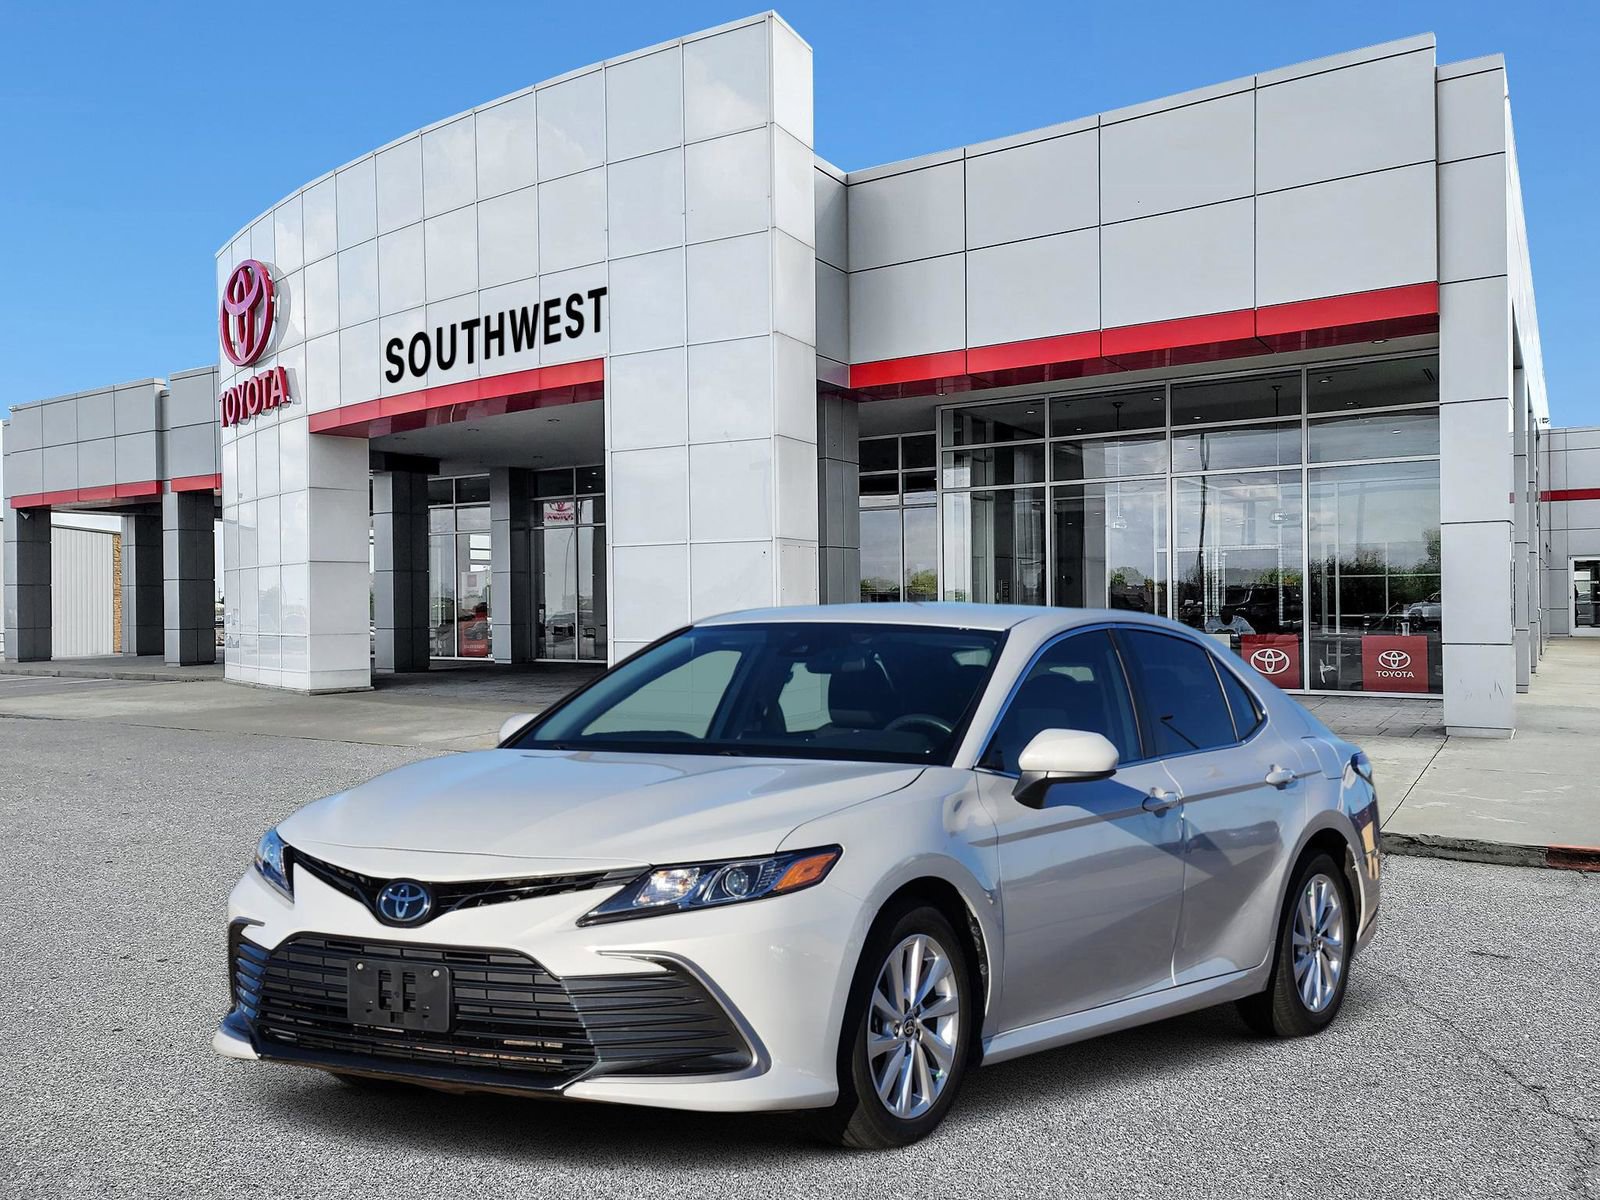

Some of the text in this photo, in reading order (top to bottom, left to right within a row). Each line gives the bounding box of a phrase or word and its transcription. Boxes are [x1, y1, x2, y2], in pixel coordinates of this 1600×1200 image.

[385, 286, 608, 384] SOUTHWEST
[219, 366, 289, 428] TOYOTA
[1375, 670, 1415, 678] TOYOTA
